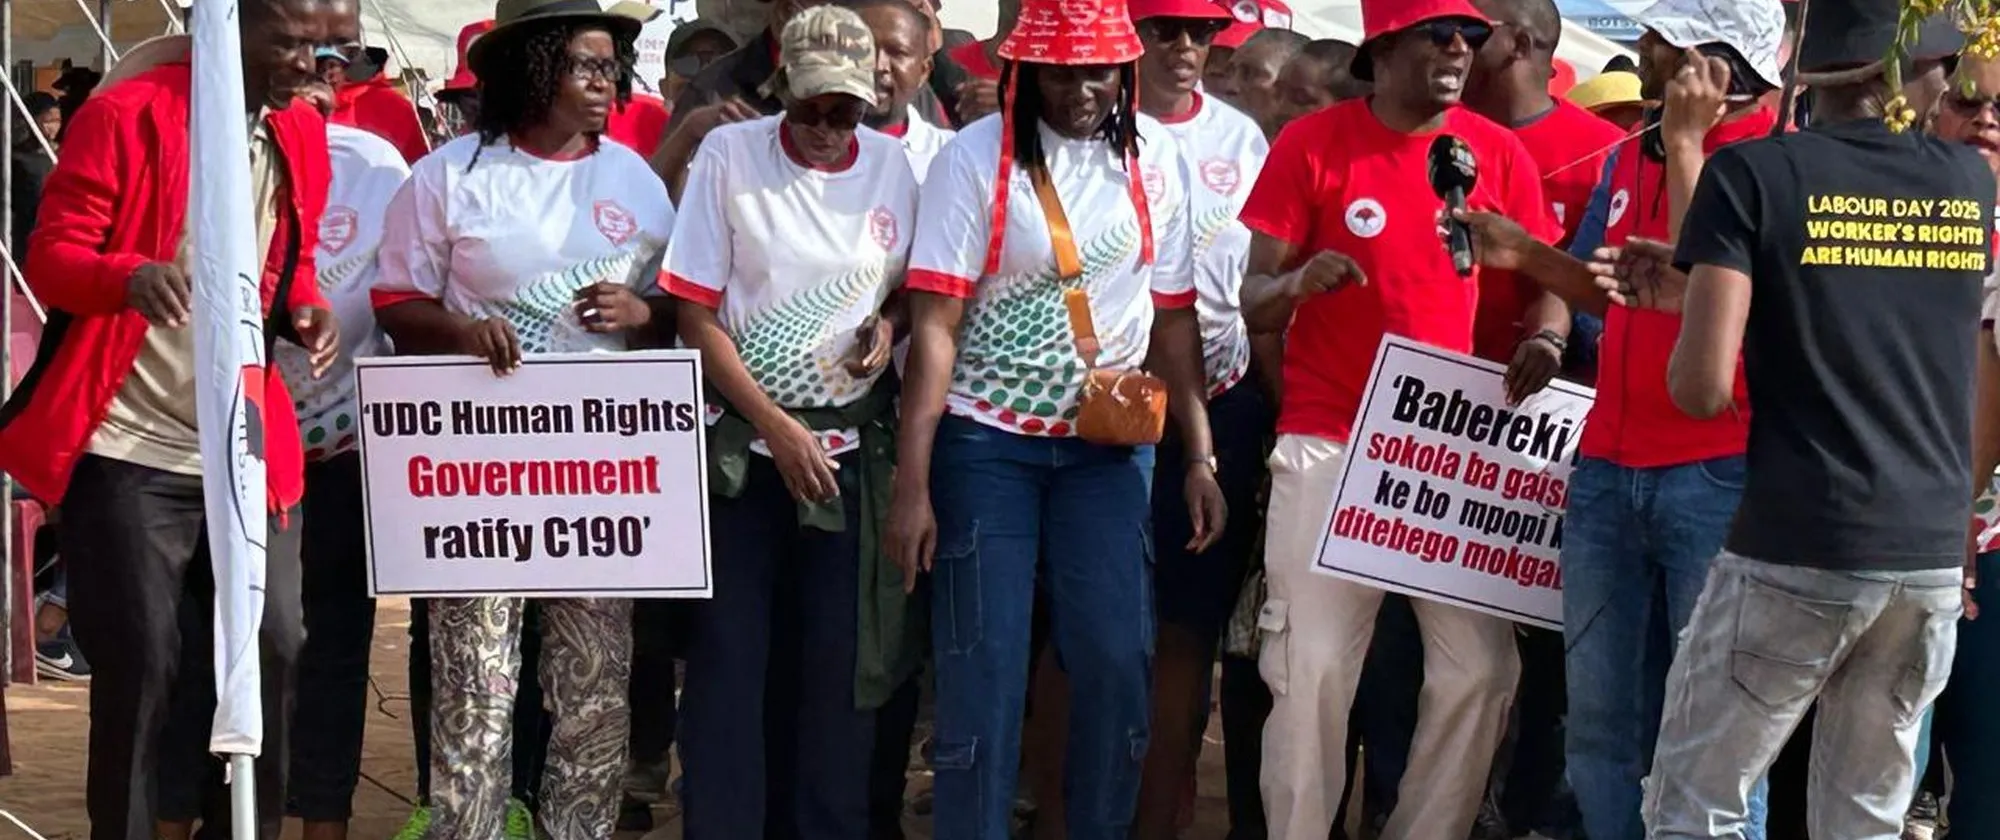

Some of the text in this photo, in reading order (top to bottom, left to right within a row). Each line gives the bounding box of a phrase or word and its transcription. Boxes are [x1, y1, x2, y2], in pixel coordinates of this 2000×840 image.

[1807, 195, 1981, 220] LABOUR DAY 2025
[1806, 220, 1984, 245] WORKER'S RIGHTS
[1800, 246, 1986, 271] ARE HUMAN RIGHTS
[451, 400, 574, 435] Human
[582, 398, 696, 436] Rights
[408, 455, 662, 498] Government
[1367, 432, 1461, 480] sokola
[1463, 452, 1500, 491] ba
[1374, 470, 1410, 510] ke
[1413, 480, 1450, 520] bo
[1459, 498, 1549, 546] mpopi
[424, 517, 533, 562] ratify
[1333, 505, 1459, 563] ditebego
